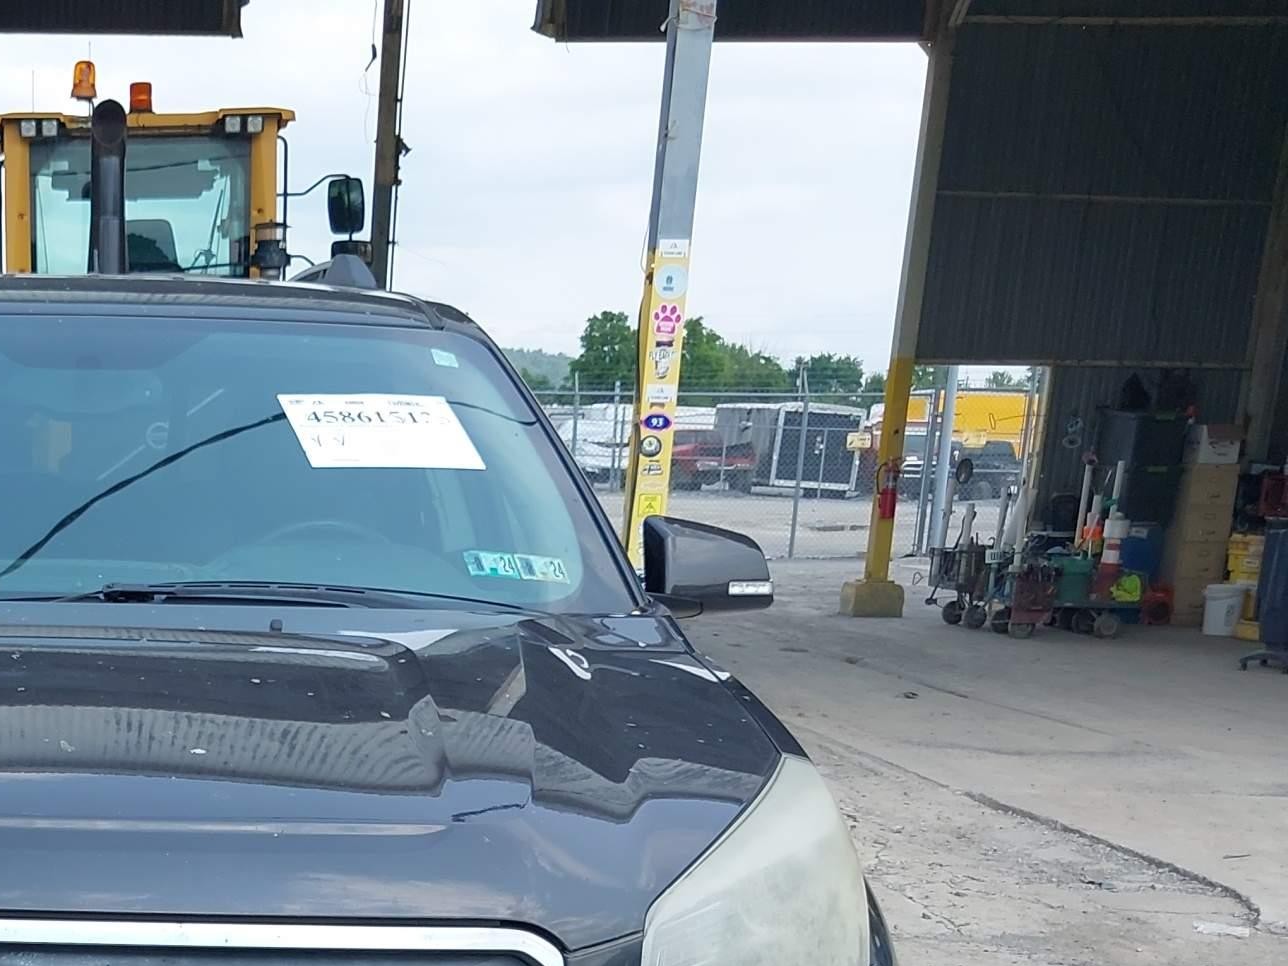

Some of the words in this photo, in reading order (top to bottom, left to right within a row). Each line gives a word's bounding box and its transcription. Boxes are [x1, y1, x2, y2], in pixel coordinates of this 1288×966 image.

[651, 417, 665, 427] 93
[499, 556, 515, 573] 24
[550, 560, 566, 578] 24
